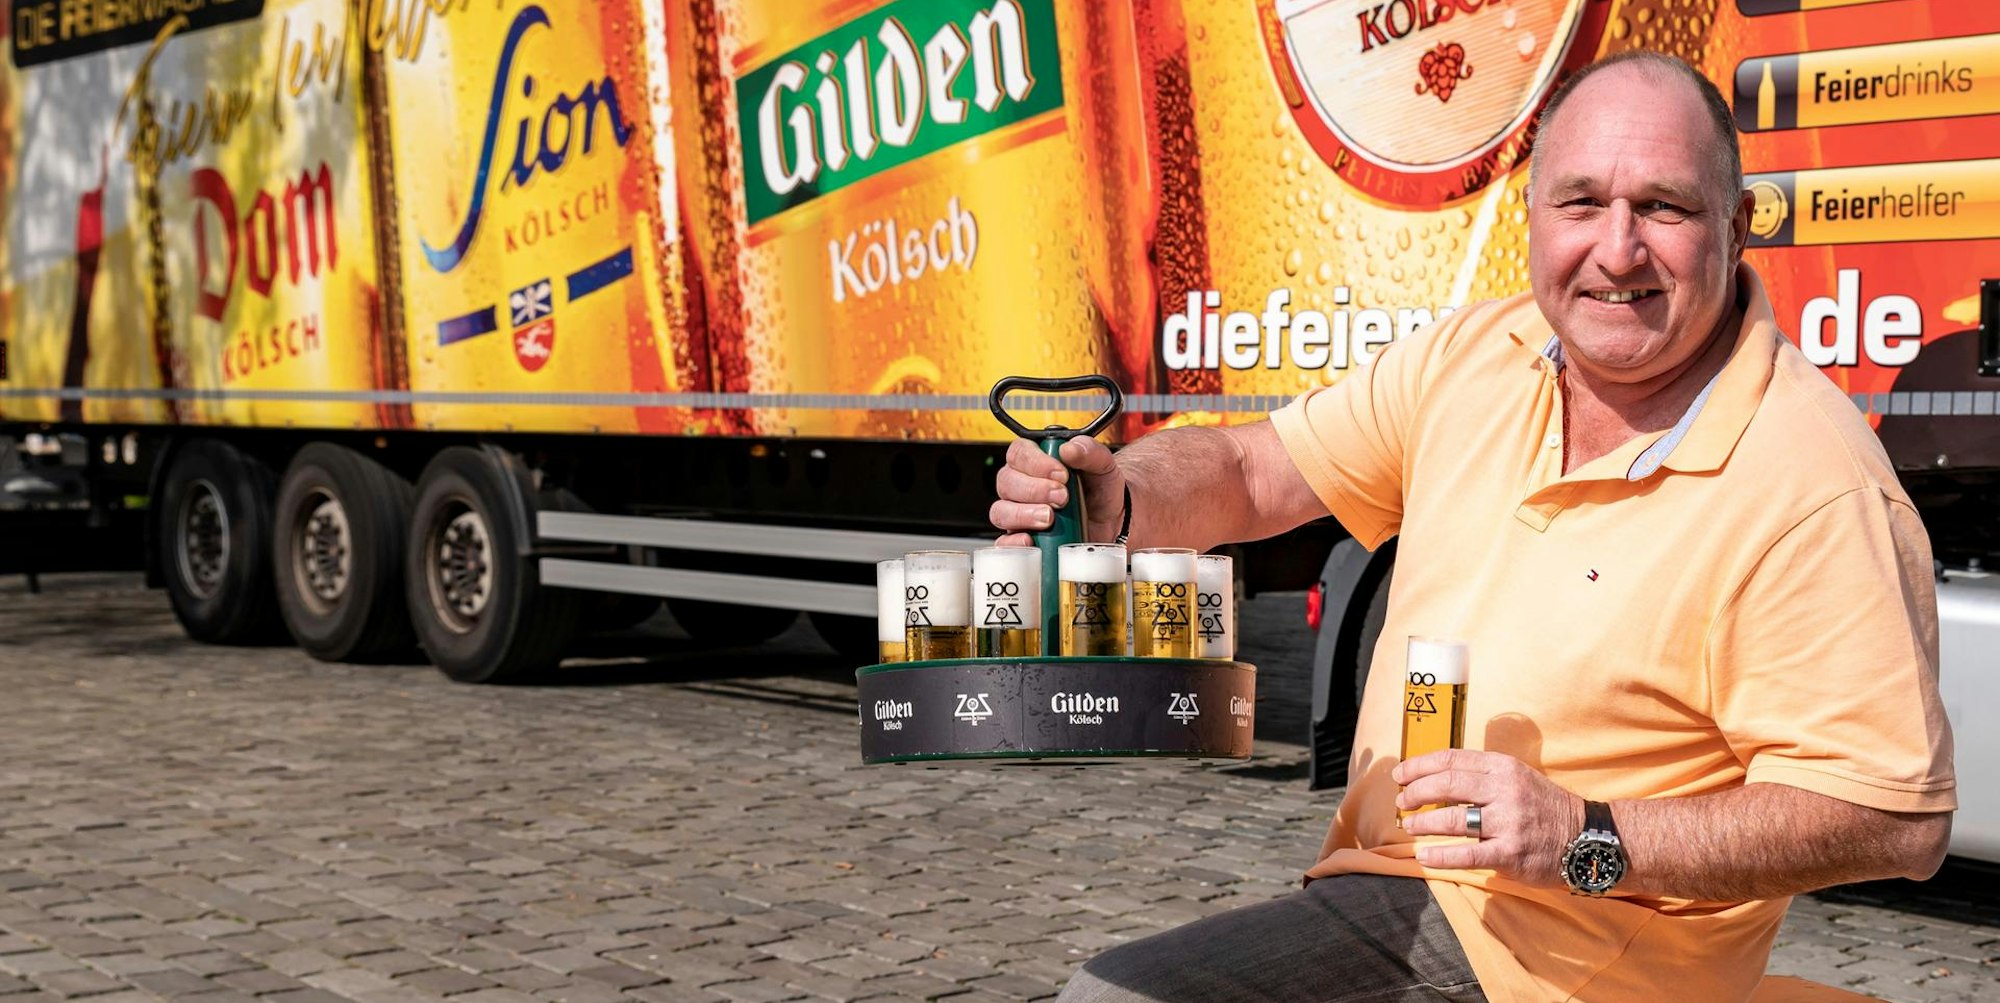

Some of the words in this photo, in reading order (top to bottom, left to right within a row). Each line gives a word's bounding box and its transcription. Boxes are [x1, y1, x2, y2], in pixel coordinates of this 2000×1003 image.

[16, 4, 55, 50] DIE
[758, 0, 1036, 194] Gilden
[1814, 60, 1974, 104] Feierdrinks
[419, 3, 635, 273] Sion
[503, 182, 610, 254] KÖLSCH
[1811, 183, 1965, 222] Feierhelfer
[190, 161, 341, 324] Dom
[828, 196, 979, 302] Kölsch
[221, 313, 320, 384] KÖLSCH
[986, 582, 1019, 597] 100
[1075, 583, 1107, 597] 100
[1154, 583, 1187, 598] 100
[1198, 592, 1223, 607] 00
[1409, 671, 1436, 687] 100
[874, 699, 914, 720] Gilden
[1051, 692, 1120, 714] Gilden
[1069, 714, 1103, 725] Kölsch
